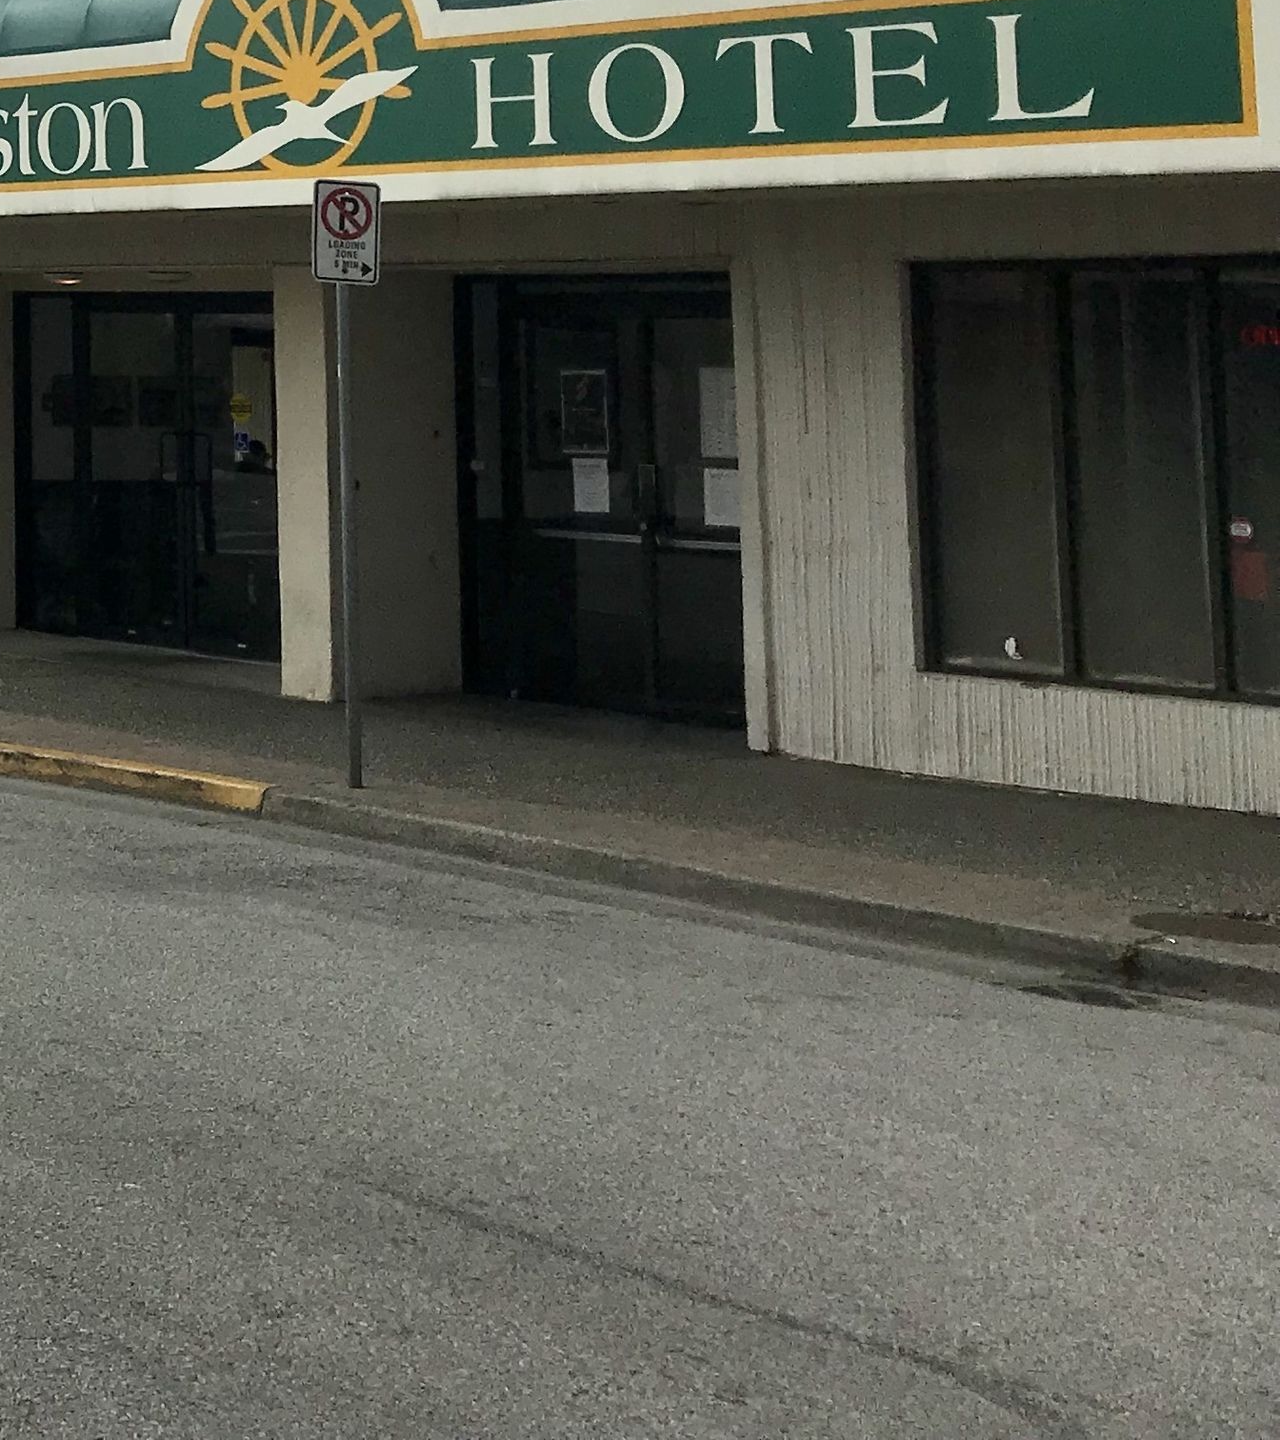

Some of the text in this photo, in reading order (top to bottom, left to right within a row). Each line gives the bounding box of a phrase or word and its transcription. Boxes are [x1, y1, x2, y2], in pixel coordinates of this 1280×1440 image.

[470, 13, 1095, 151] HOTEL
[328, 240, 366, 250] LOADING
[335, 250, 358, 259] ZONE
[342, 260, 358, 269] MIN
